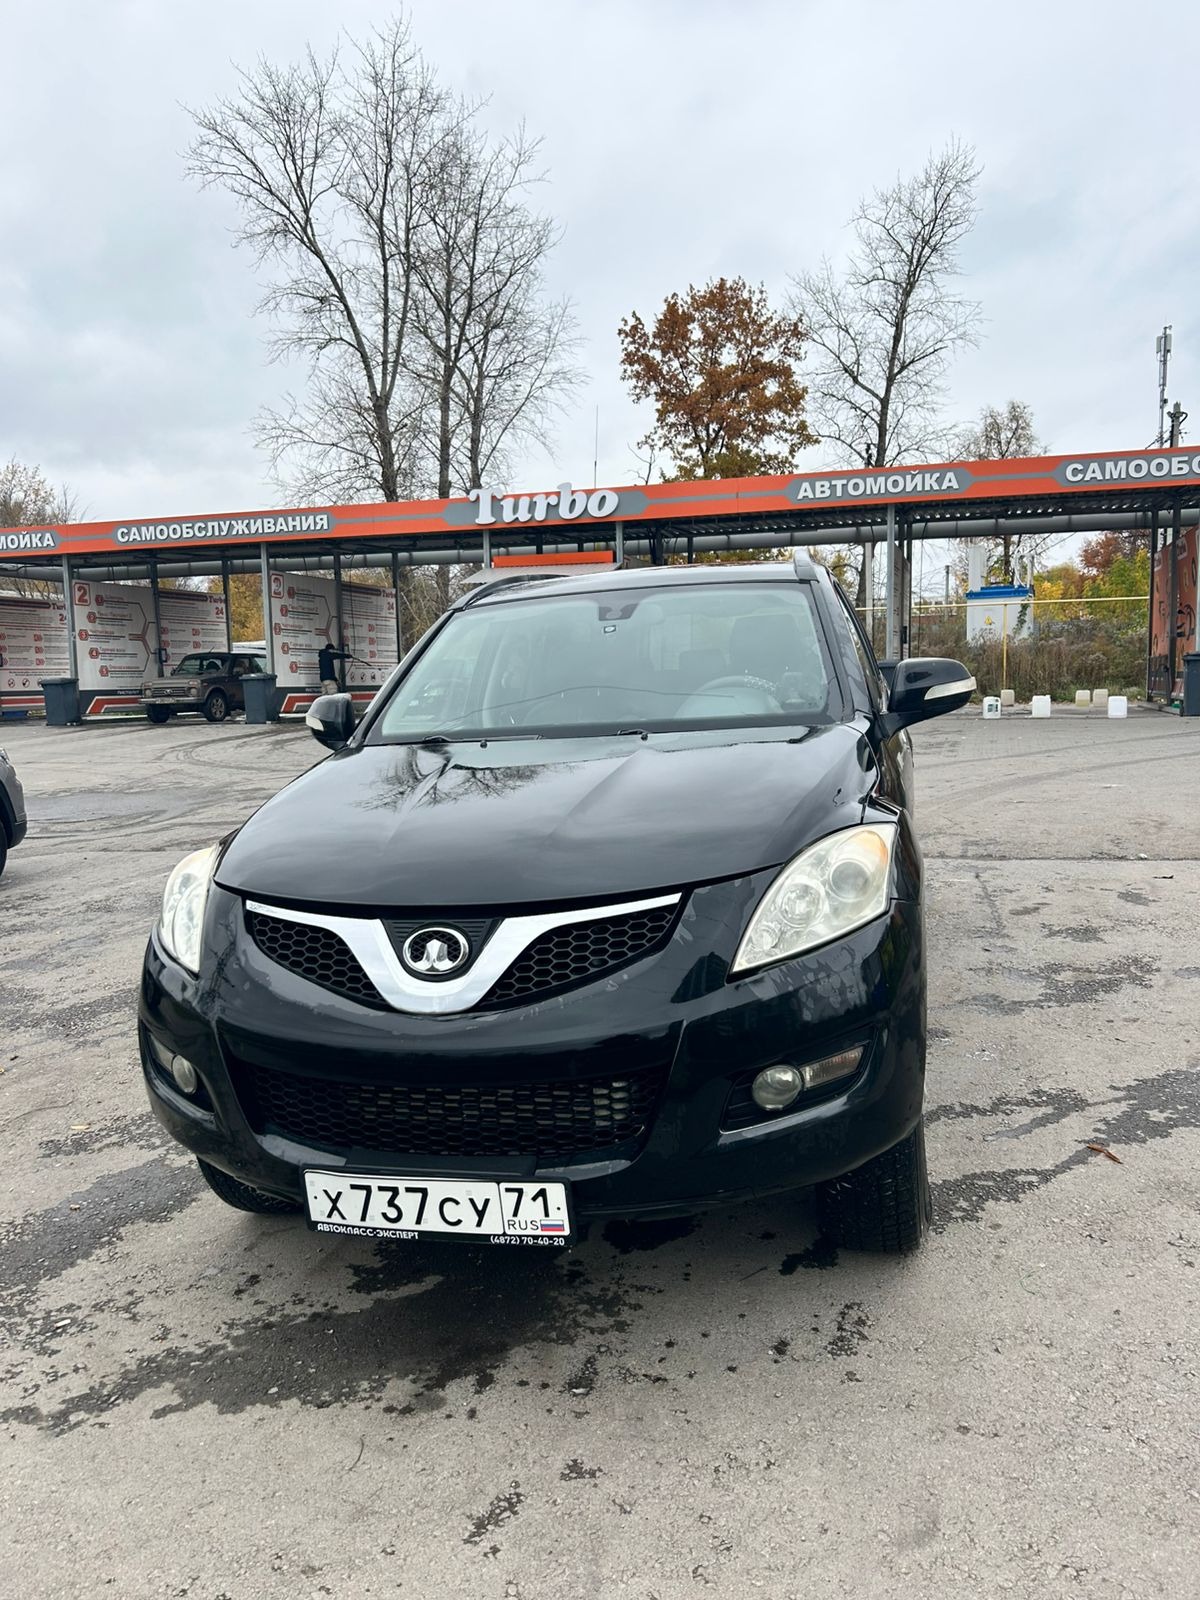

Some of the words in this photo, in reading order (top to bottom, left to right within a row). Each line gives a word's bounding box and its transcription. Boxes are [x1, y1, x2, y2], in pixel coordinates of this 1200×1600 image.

[797, 470, 960, 500] АВТОМОЙКА
[468, 482, 619, 525] Turbo
[117, 514, 329, 543] САМООБСЛУЖИВАНИЯ
[77, 585, 89, 604] 2
[272, 577, 282, 596] 2
[215, 606, 224, 617] 24
[504, 1187, 550, 1218] 71
[507, 1219, 539, 1231] RUS
[490, 1235, 520, 1245] (4872)
[521, 1236, 565, 1246] 70-40-20
